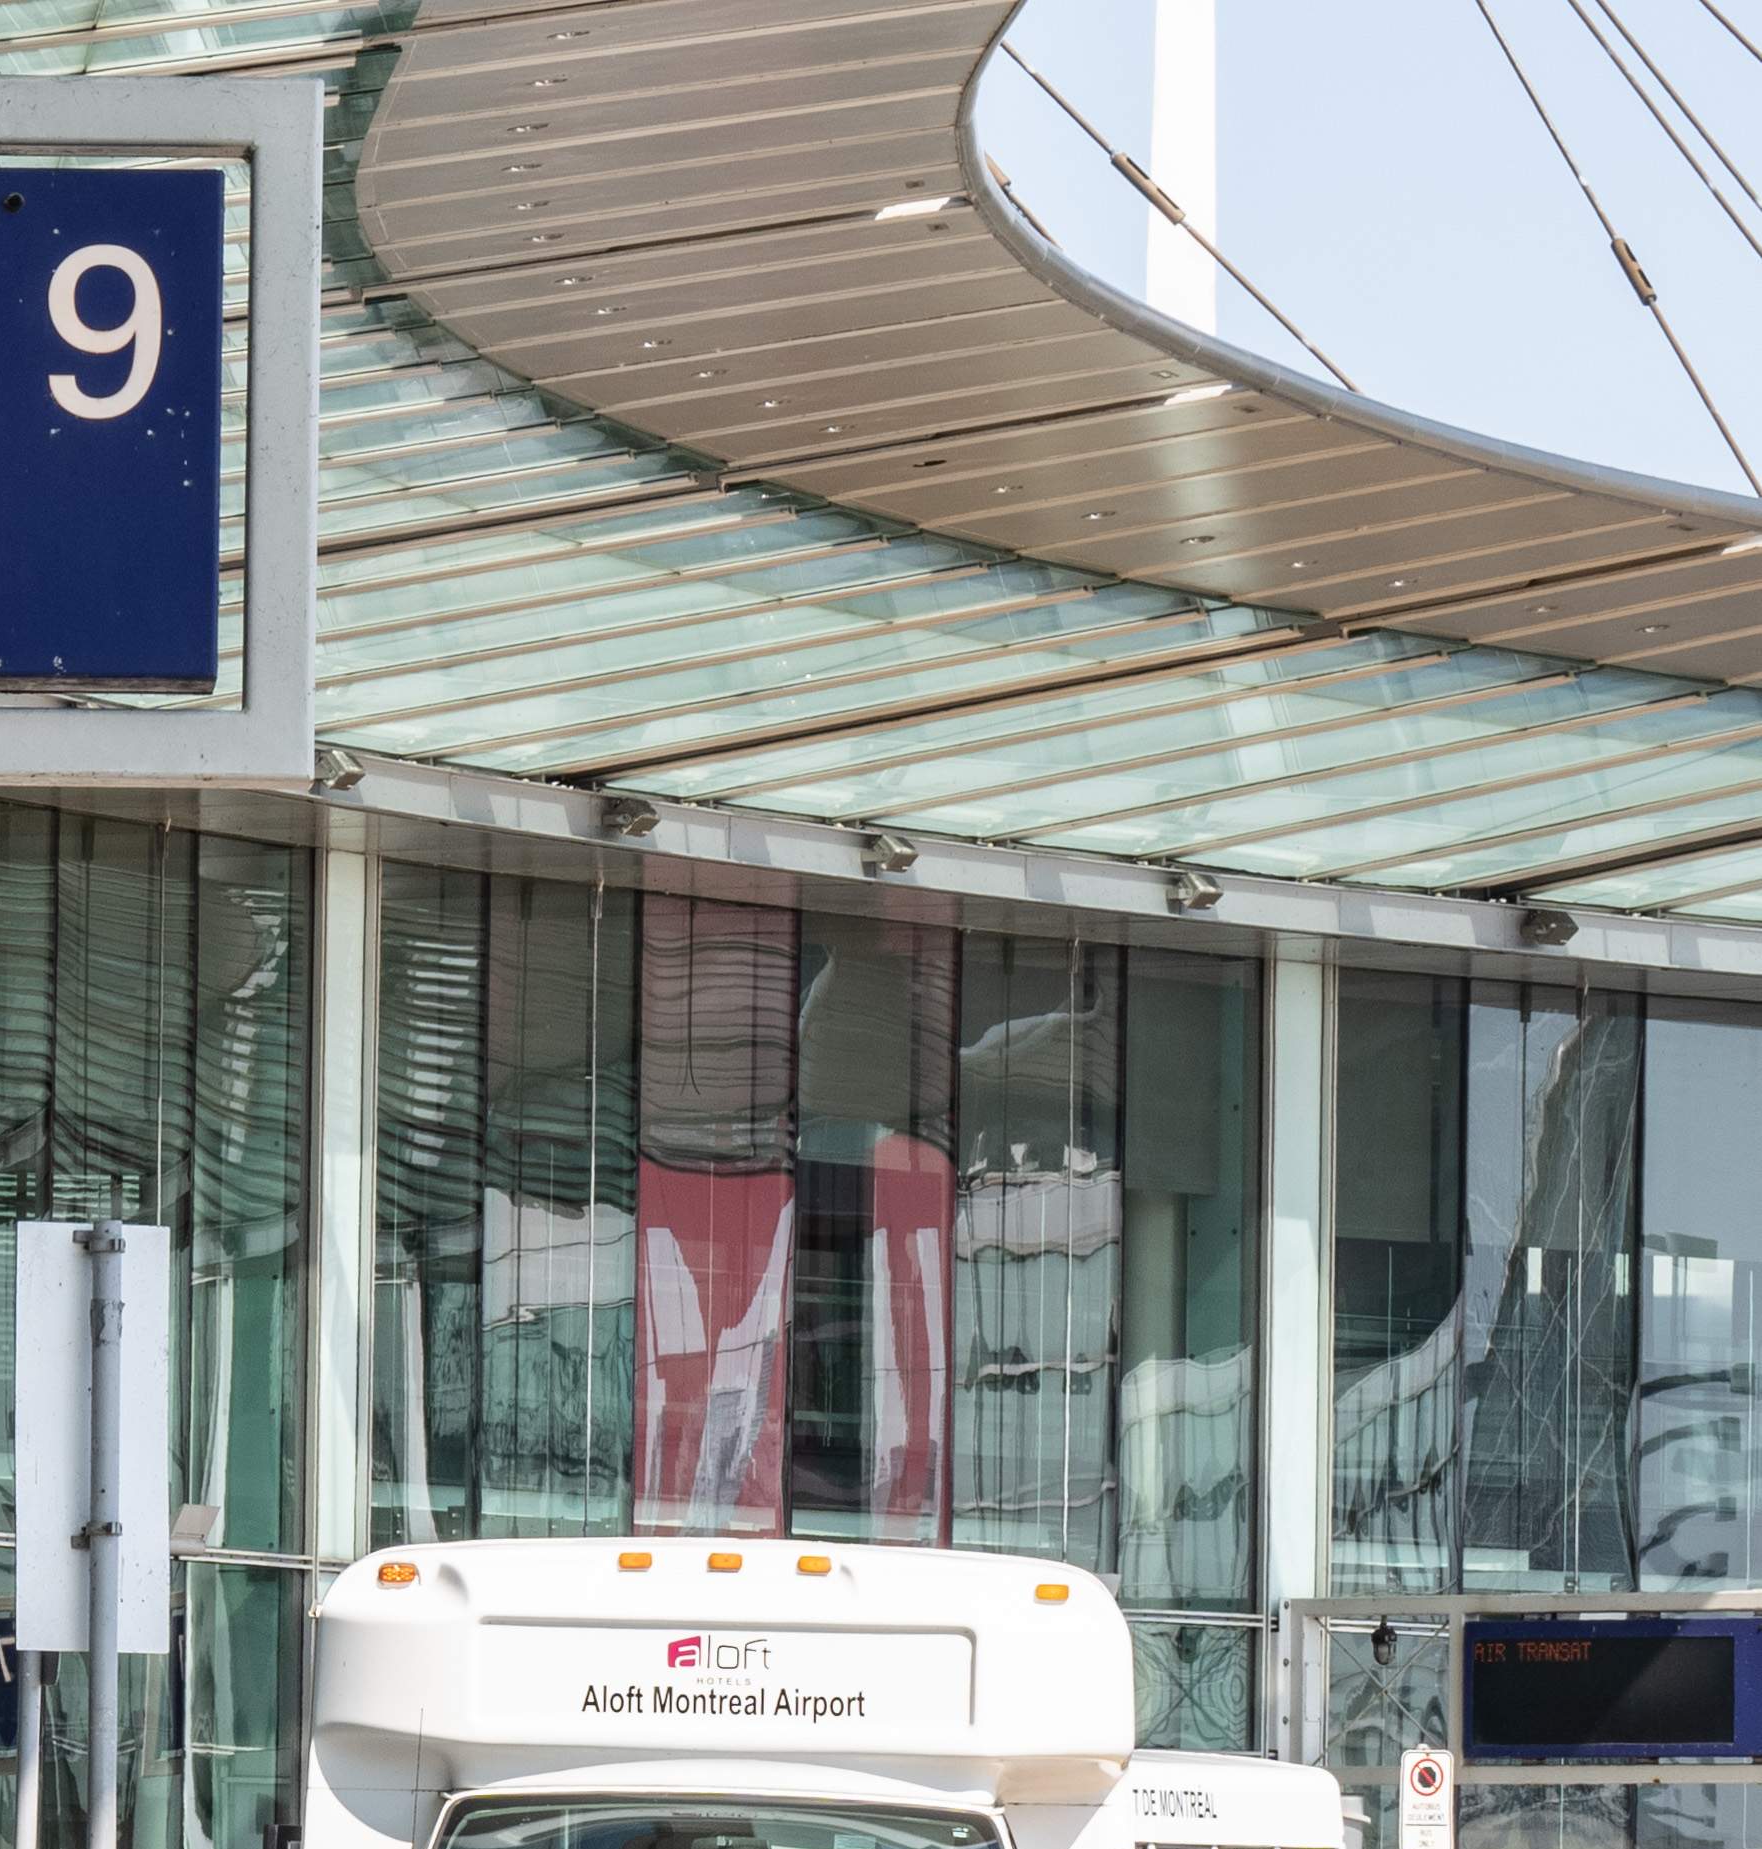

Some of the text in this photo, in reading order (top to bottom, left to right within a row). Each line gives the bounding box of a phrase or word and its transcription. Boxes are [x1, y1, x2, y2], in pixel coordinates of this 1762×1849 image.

[47, 243, 163, 421] 9
[1475, 1641, 1591, 1662] AIR TRANSAT
[696, 1677, 752, 1686] HOTELS
[581, 1684, 865, 1723] Aloft Montreal Airport
[1142, 1789, 1157, 1816] DE
